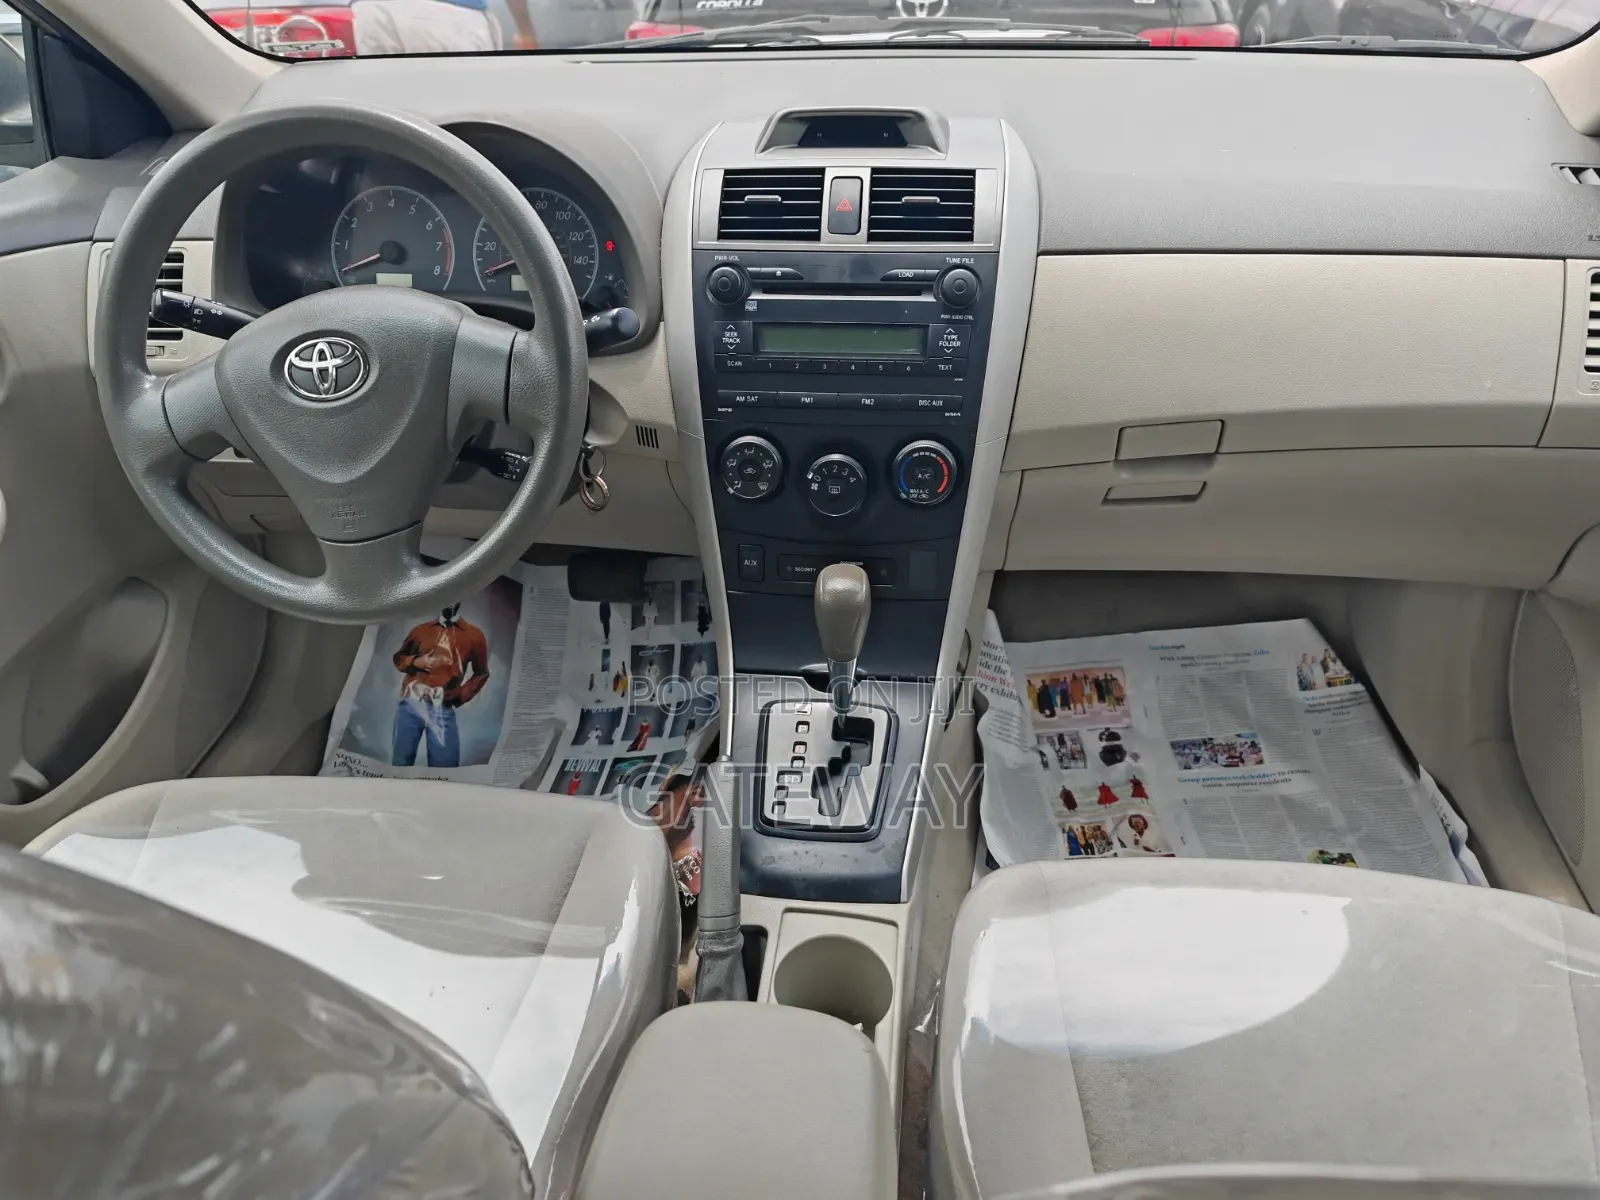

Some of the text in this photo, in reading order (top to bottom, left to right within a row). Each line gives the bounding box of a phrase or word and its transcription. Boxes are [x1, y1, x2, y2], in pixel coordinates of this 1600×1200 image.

[366, 203, 374, 212] 3
[387, 198, 395, 208] 4
[535, 200, 548, 210] 80
[409, 204, 417, 214] 5
[555, 210, 571, 221] 100
[350, 217, 358, 228] 2
[425, 220, 433, 230] 6
[568, 231, 584, 241] 120
[344, 240, 349, 250] 1
[435, 241, 443, 252] 7
[483, 241, 497, 251] 20
[573, 255, 589, 265] 140
[433, 265, 441, 275] 8
[832, 464, 839, 473] 2
[842, 467, 849, 476] 3
[743, 559, 758, 567] AUX
[564, 758, 602, 773] REVIVAL
[1259, 777, 1293, 787] residents
